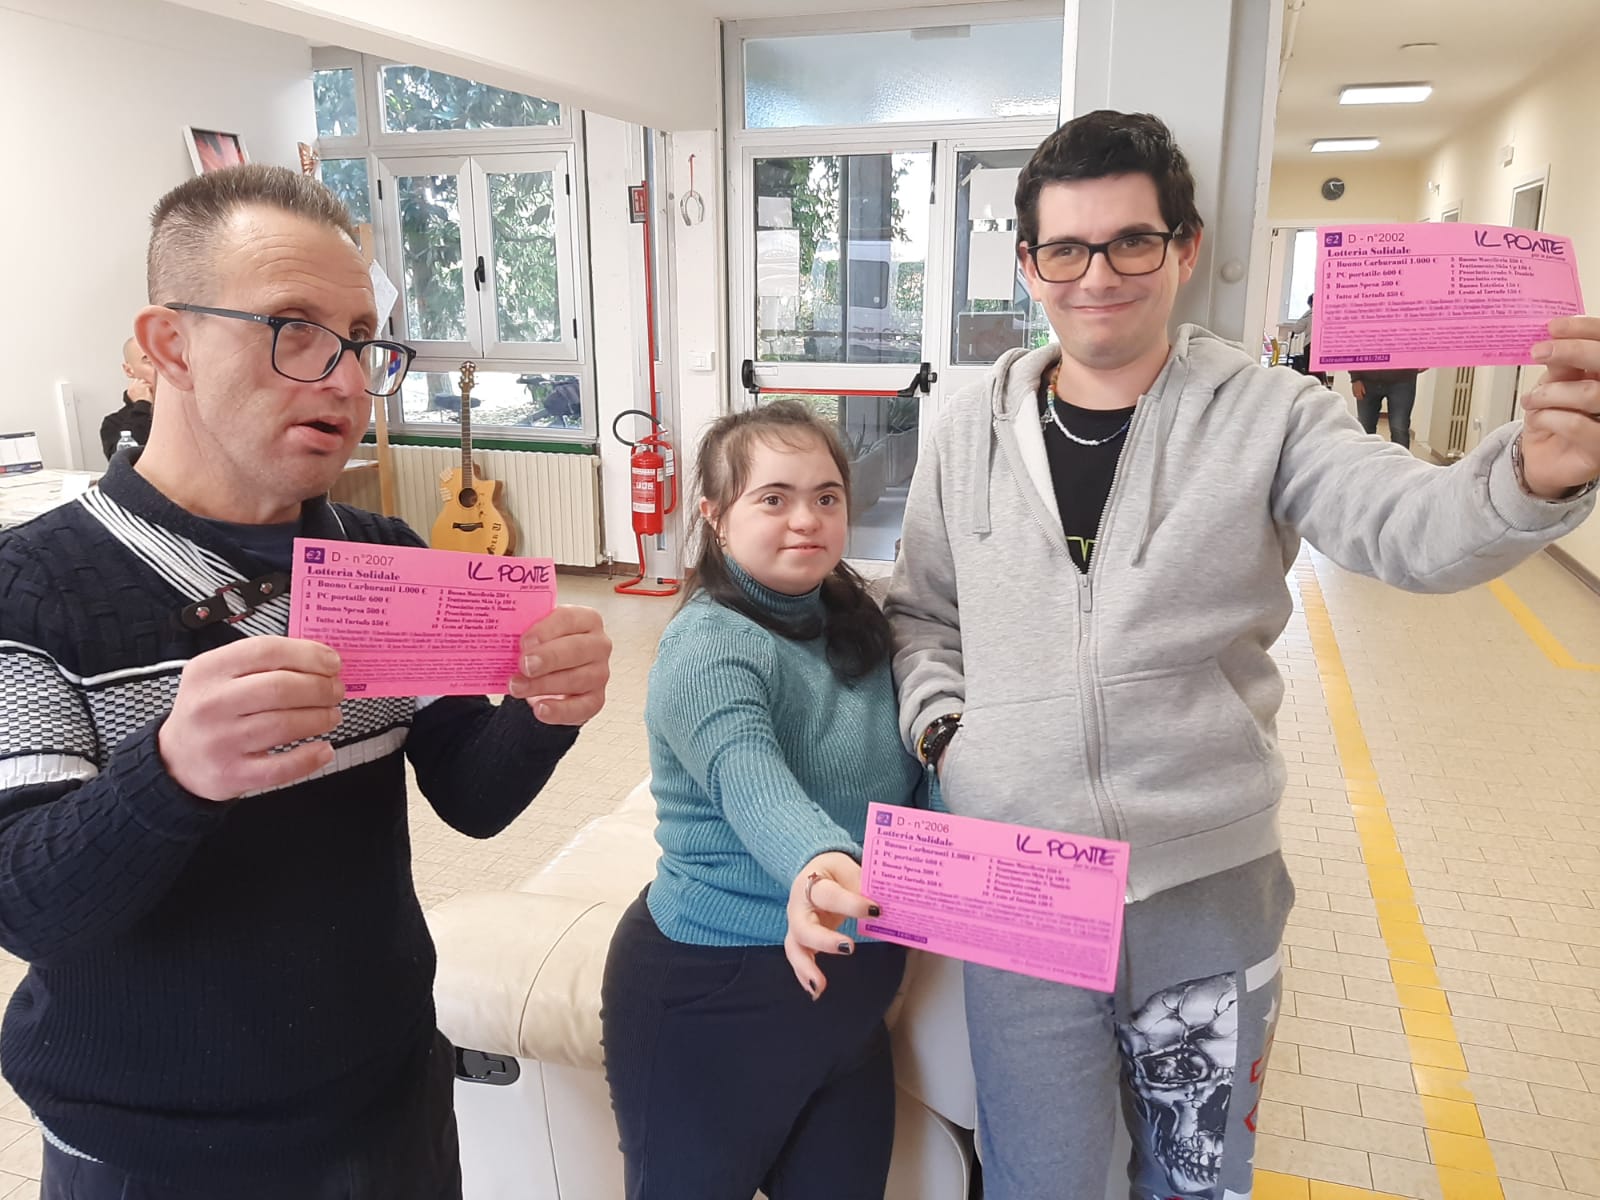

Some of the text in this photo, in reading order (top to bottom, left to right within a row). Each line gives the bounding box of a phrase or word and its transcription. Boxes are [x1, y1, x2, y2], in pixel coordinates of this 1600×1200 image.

[1348, 234, 1356, 243] D
[1367, 233, 1404, 242] n°2002
[1474, 230, 1566, 254] IL PONTE
[1327, 247, 1410, 257] Lotteria Solidale
[1349, 271, 1380, 279] portatile
[332, 552, 340, 562] D
[353, 554, 394, 566] n°2007
[308, 566, 400, 581] Lotteria Solidale
[468, 561, 550, 583] IL PONTE
[318, 580, 346, 588] Buono
[349, 582, 396, 592] Carburanti
[331, 593, 366, 601] portatile
[317, 604, 341, 612] Buono
[344, 606, 364, 614] Spesa
[897, 817, 904, 825] D
[915, 821, 949, 833] n°2006
[877, 828, 954, 846] Lotteria Solidale
[1017, 834, 1117, 866] IL PONTE
